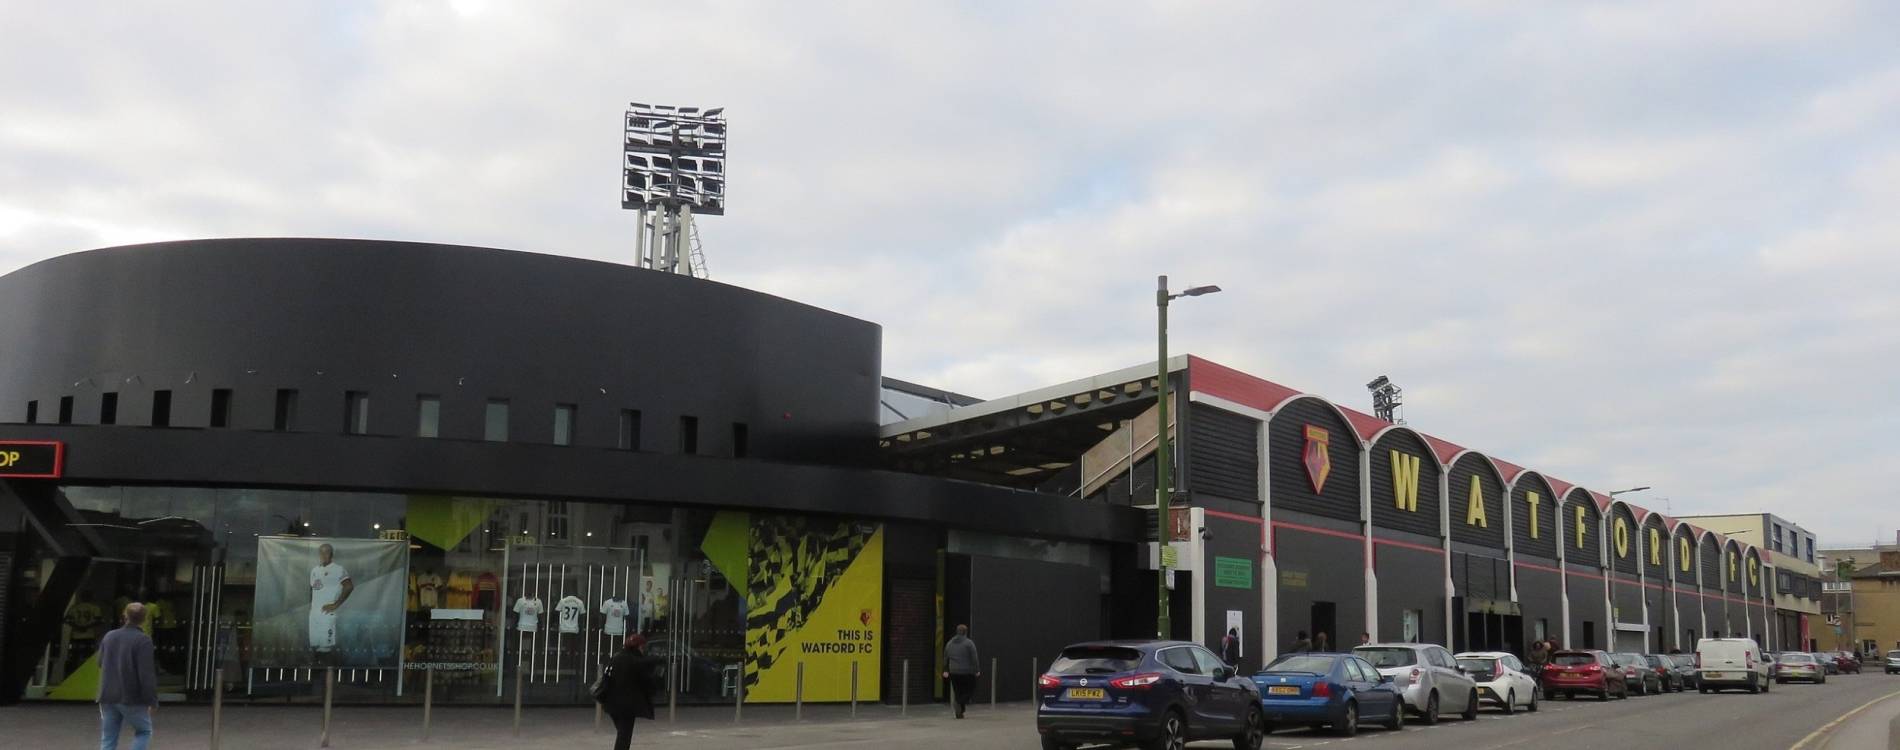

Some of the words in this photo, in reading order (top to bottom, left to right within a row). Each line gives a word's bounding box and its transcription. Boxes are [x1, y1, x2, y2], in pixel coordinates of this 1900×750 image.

[1389, 449, 1691, 573] WATFORD
[1728, 550, 1757, 588] FC
[563, 606, 578, 620] 37
[837, 629, 861, 641] THIS
[863, 630, 873, 641] IS
[801, 642, 855, 654] WATFORD
[858, 643, 873, 654] FC
